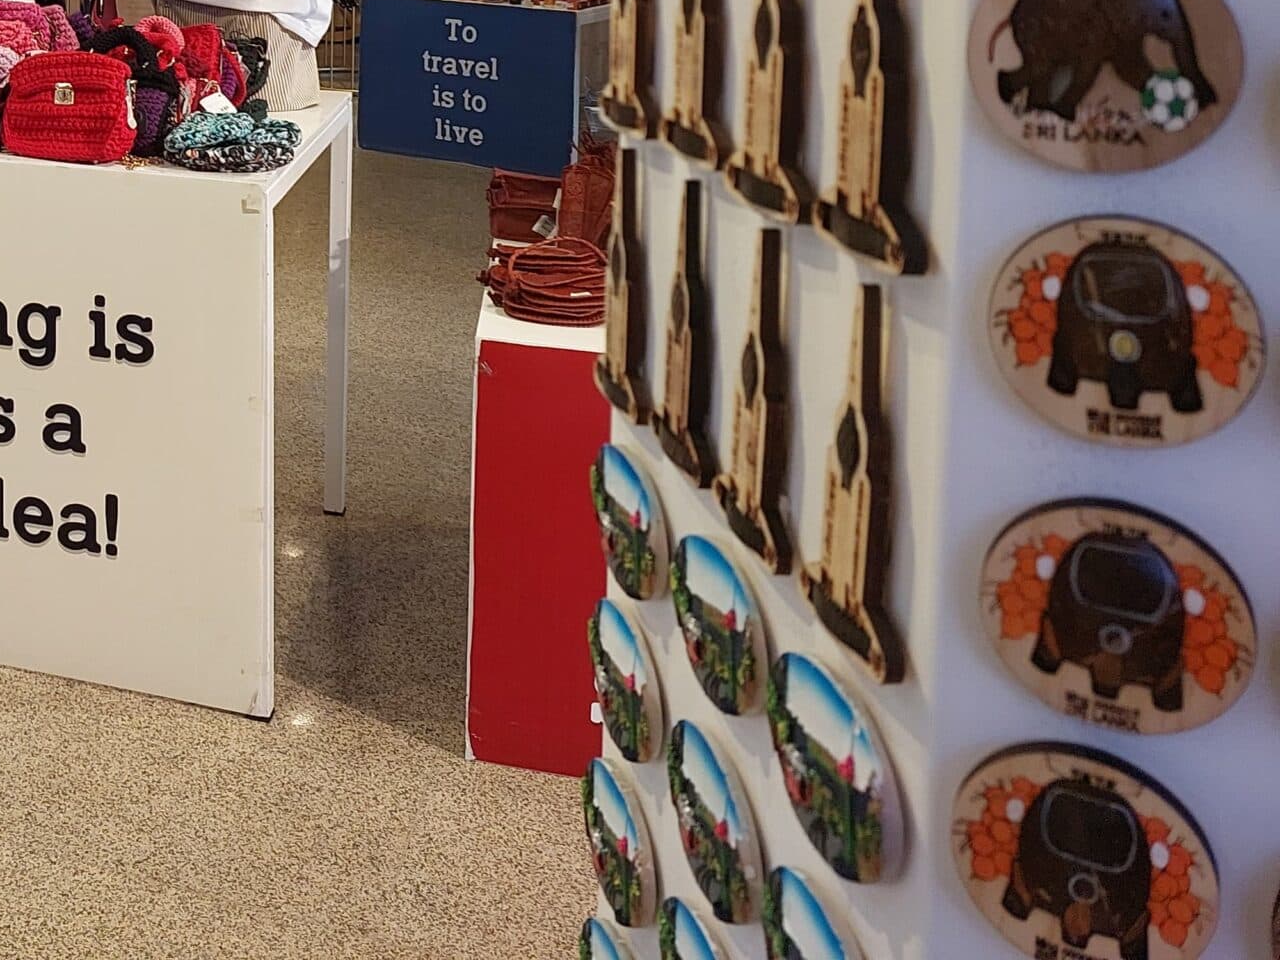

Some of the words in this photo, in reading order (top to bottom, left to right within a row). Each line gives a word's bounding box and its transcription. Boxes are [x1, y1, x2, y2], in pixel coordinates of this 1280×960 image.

[444, 18, 478, 44] To
[422, 50, 499, 80] travel
[432, 85, 455, 109] is
[463, 89, 487, 113] to
[435, 118, 484, 146] live
[88, 295, 155, 364] is
[42, 403, 87, 454] a
